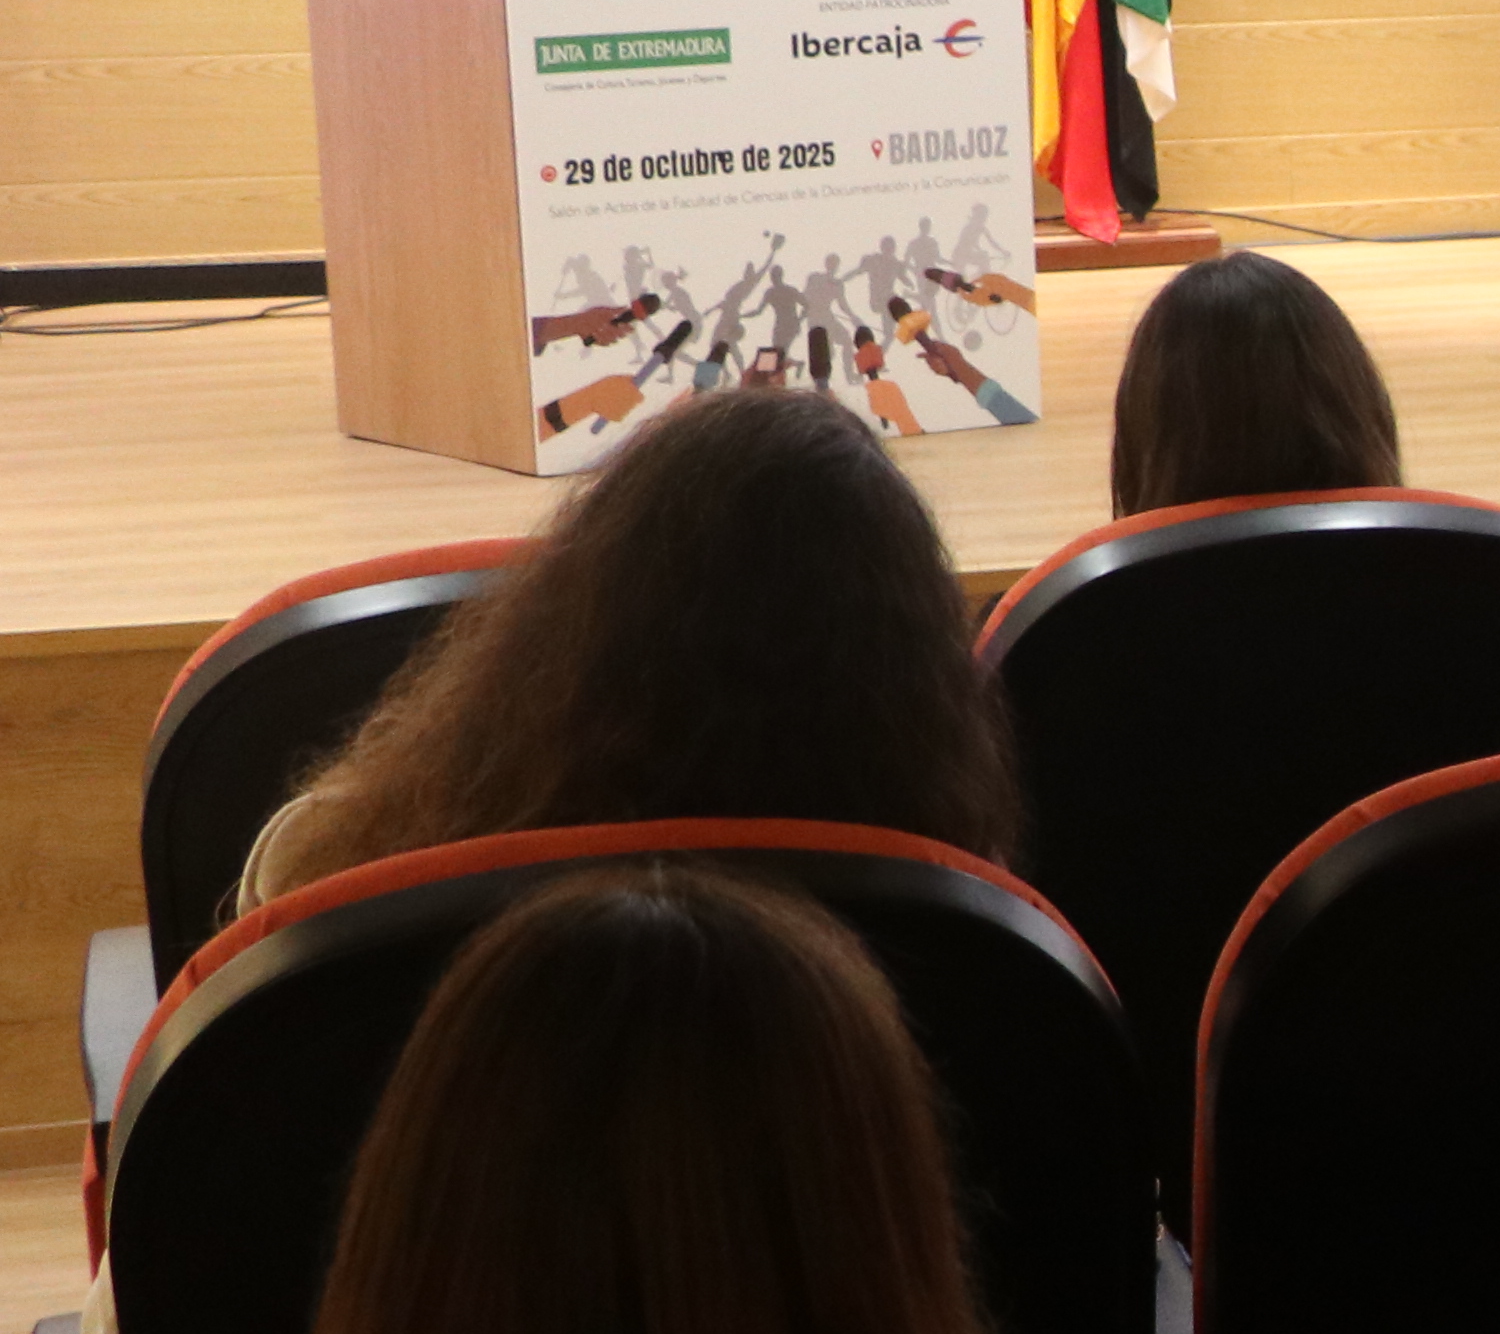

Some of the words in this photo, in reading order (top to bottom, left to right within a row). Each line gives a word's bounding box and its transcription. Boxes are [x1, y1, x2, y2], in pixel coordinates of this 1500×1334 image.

[541, 43, 586, 67] JUNTA
[593, 41, 612, 60] DE
[618, 36, 726, 59] EXTREMADURA
[791, 25, 922, 60] Ibercaja
[564, 159, 595, 186] 29
[603, 154, 632, 183] de
[641, 148, 734, 180] octubre
[742, 144, 770, 173] de
[778, 141, 836, 171] 2025
[888, 126, 1008, 166] BADAJOZ
